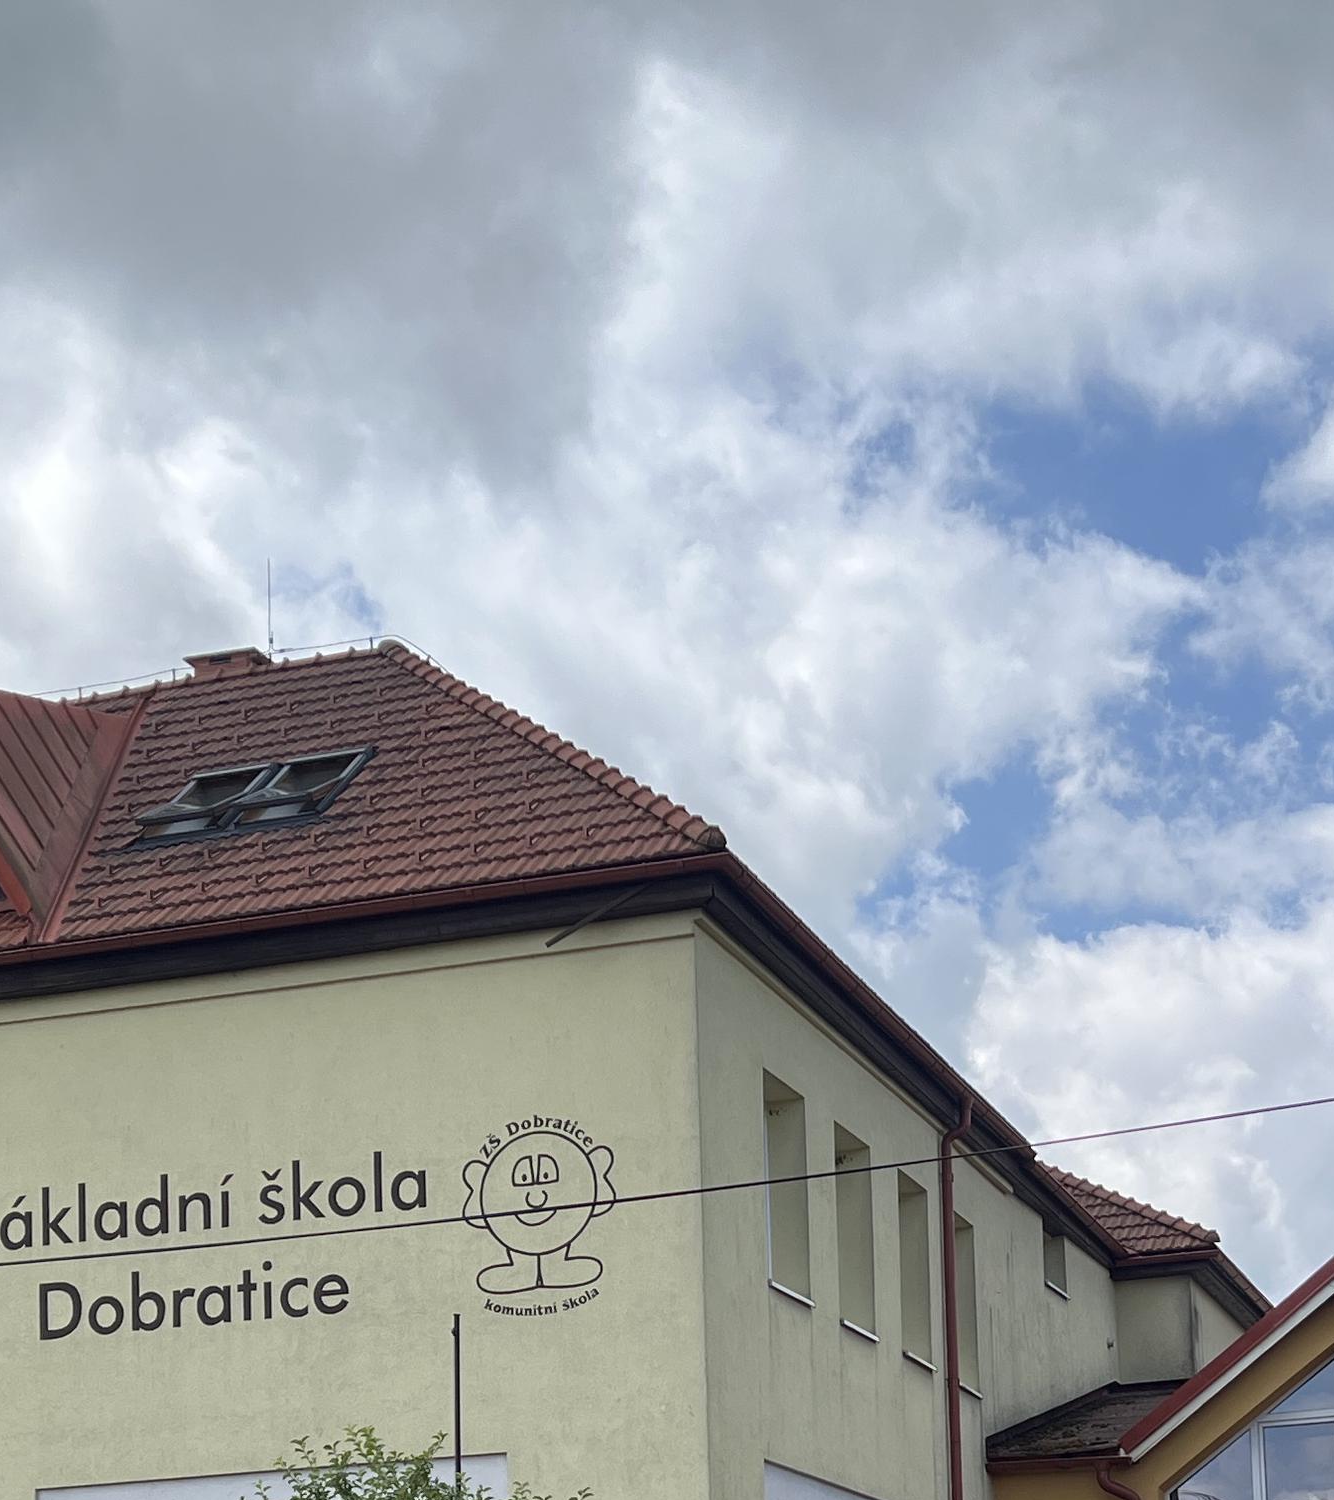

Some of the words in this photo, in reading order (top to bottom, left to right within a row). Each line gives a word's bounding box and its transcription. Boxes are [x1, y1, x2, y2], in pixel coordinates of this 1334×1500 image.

[479, 1133, 501, 1159] ZŠ
[505, 1115, 593, 1147] Dobratice
[258, 1151, 427, 1224] škola
[40, 1261, 350, 1340] Dobratice
[484, 1299, 558, 1316] komunitní
[562, 1288, 600, 1311] škola
